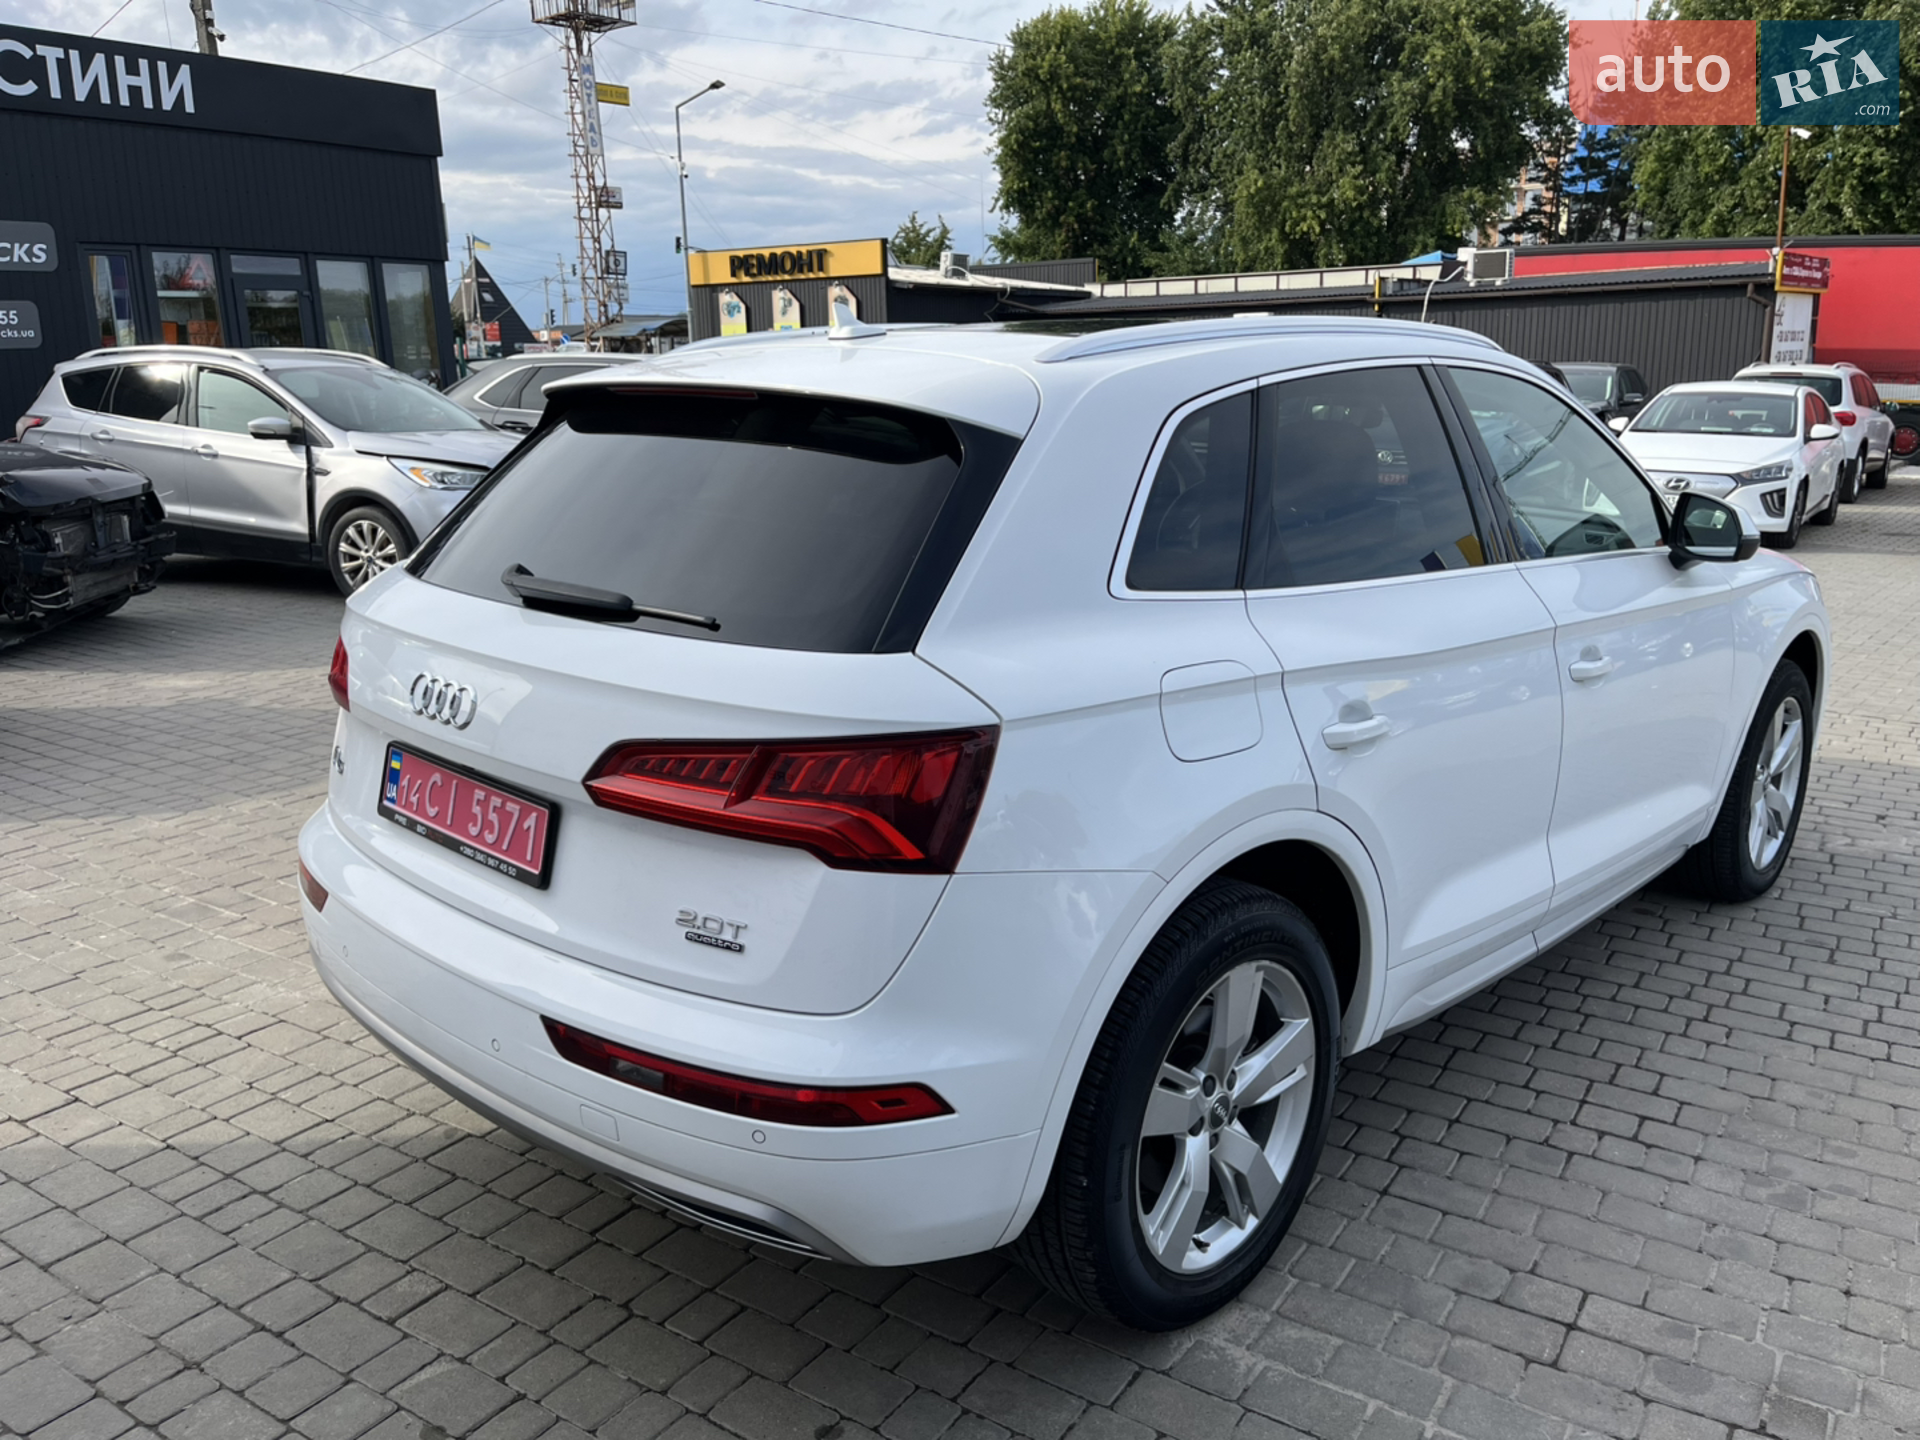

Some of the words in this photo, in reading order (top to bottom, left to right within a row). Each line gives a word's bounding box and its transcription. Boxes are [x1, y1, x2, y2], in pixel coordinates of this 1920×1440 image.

[729, 248, 828, 278] РЕМОНТ
[386, 782, 397, 800] UA
[467, 788, 538, 862] 5571
[675, 908, 748, 940] 2.0T
[687, 933, 740, 951] quattro
